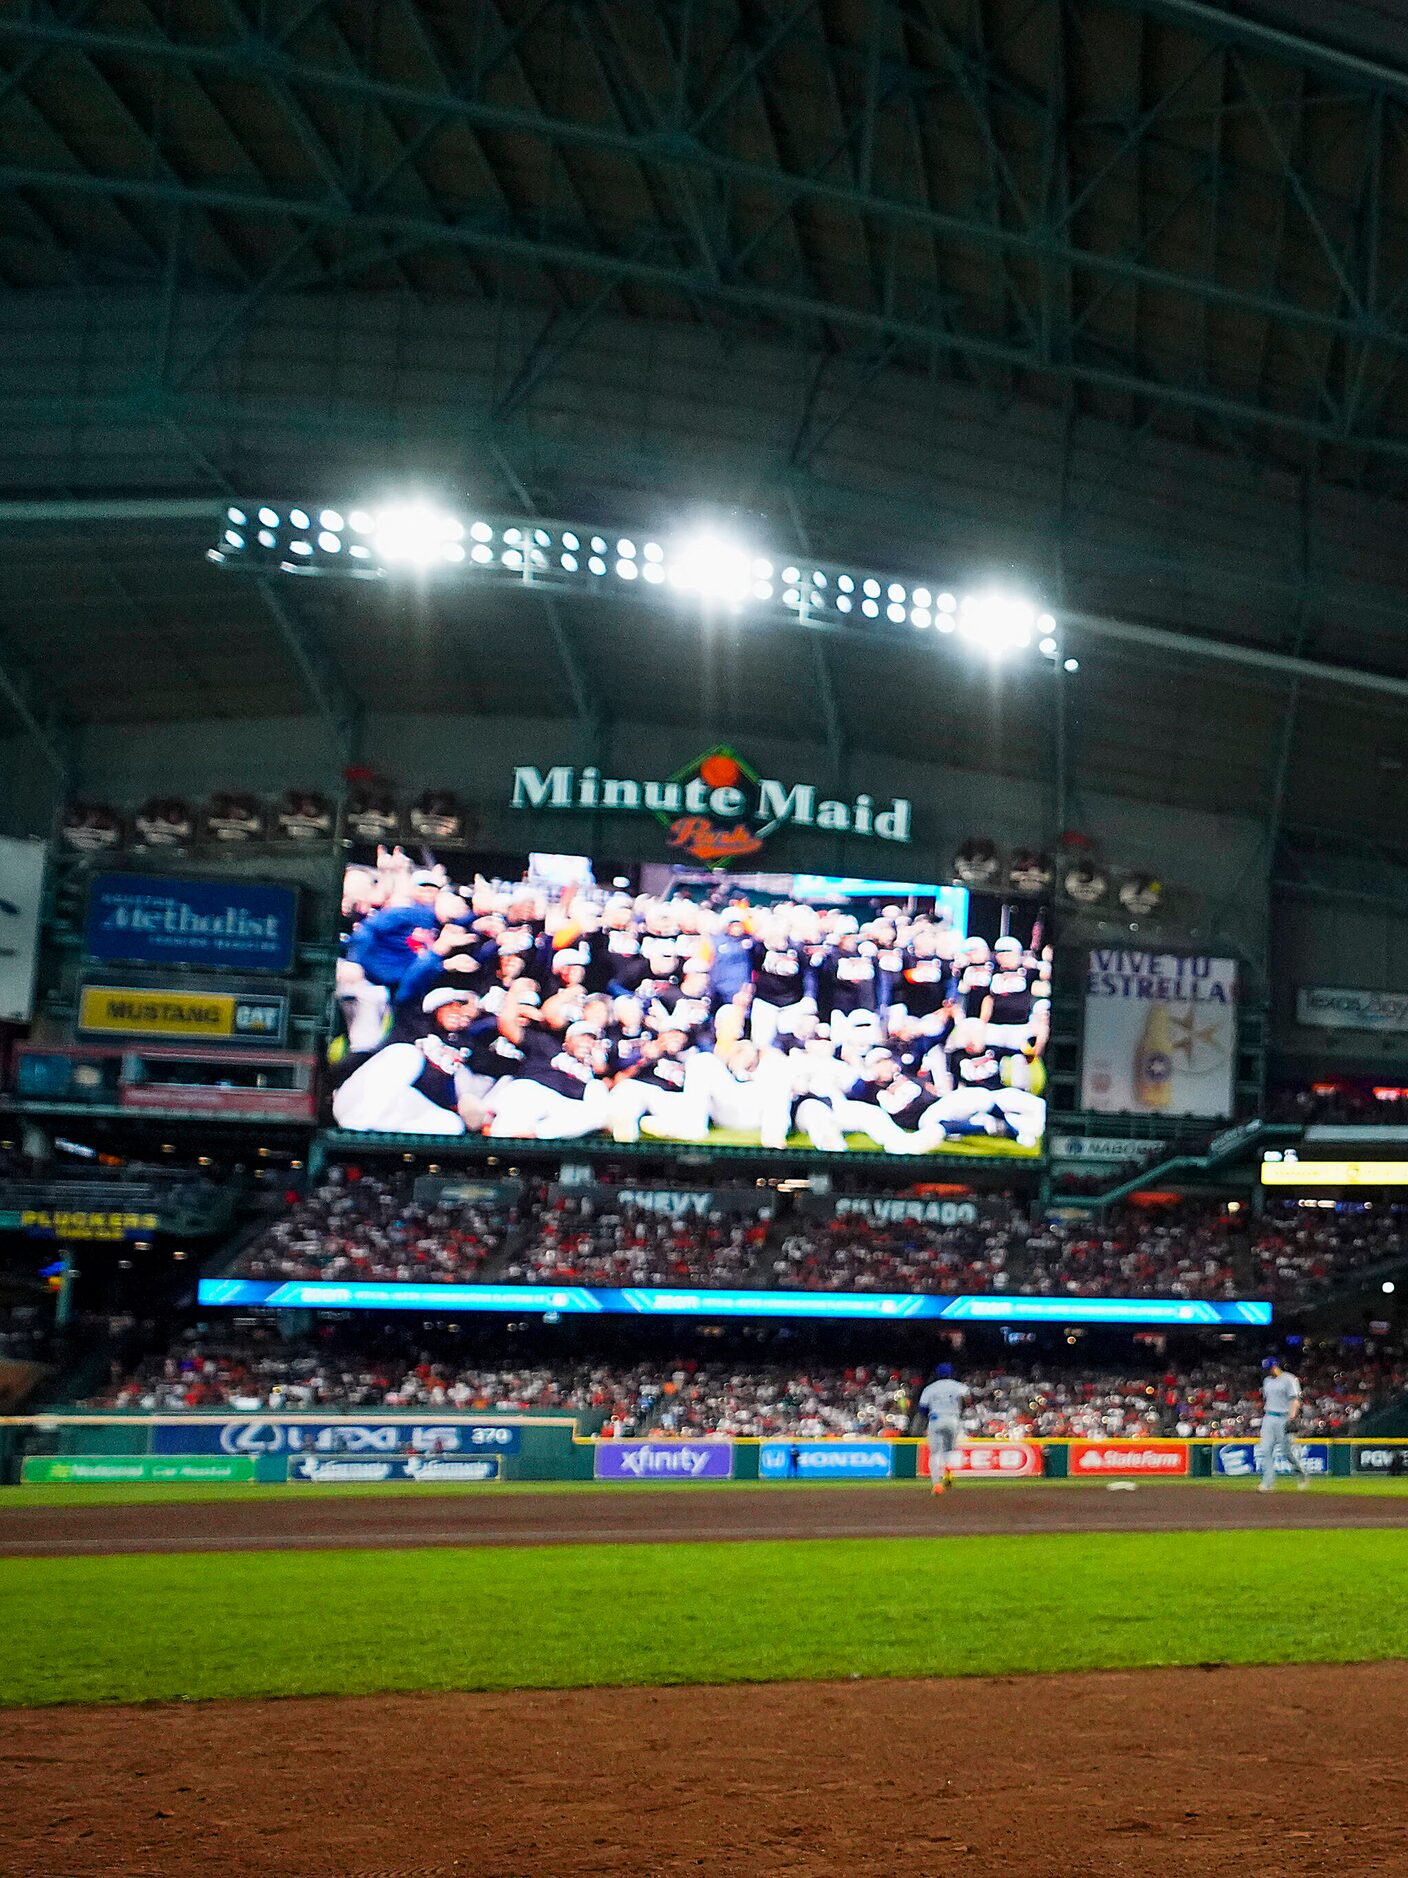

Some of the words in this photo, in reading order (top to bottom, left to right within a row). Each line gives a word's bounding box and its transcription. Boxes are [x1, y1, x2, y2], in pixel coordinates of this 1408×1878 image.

[510, 765, 745, 817] Minute
[754, 779, 912, 843] Maid
[1094, 950, 1164, 976] VIVE
[1175, 957, 1211, 978] TU
[1088, 974, 1227, 1004] ESTRELLA
[107, 1001, 221, 1024] MUSTANG
[236, 1005, 278, 1031] CAT
[835, 1197, 977, 1226] SILVERADO
[471, 1427, 514, 1445] 370
[620, 1445, 711, 1475] xfinity
